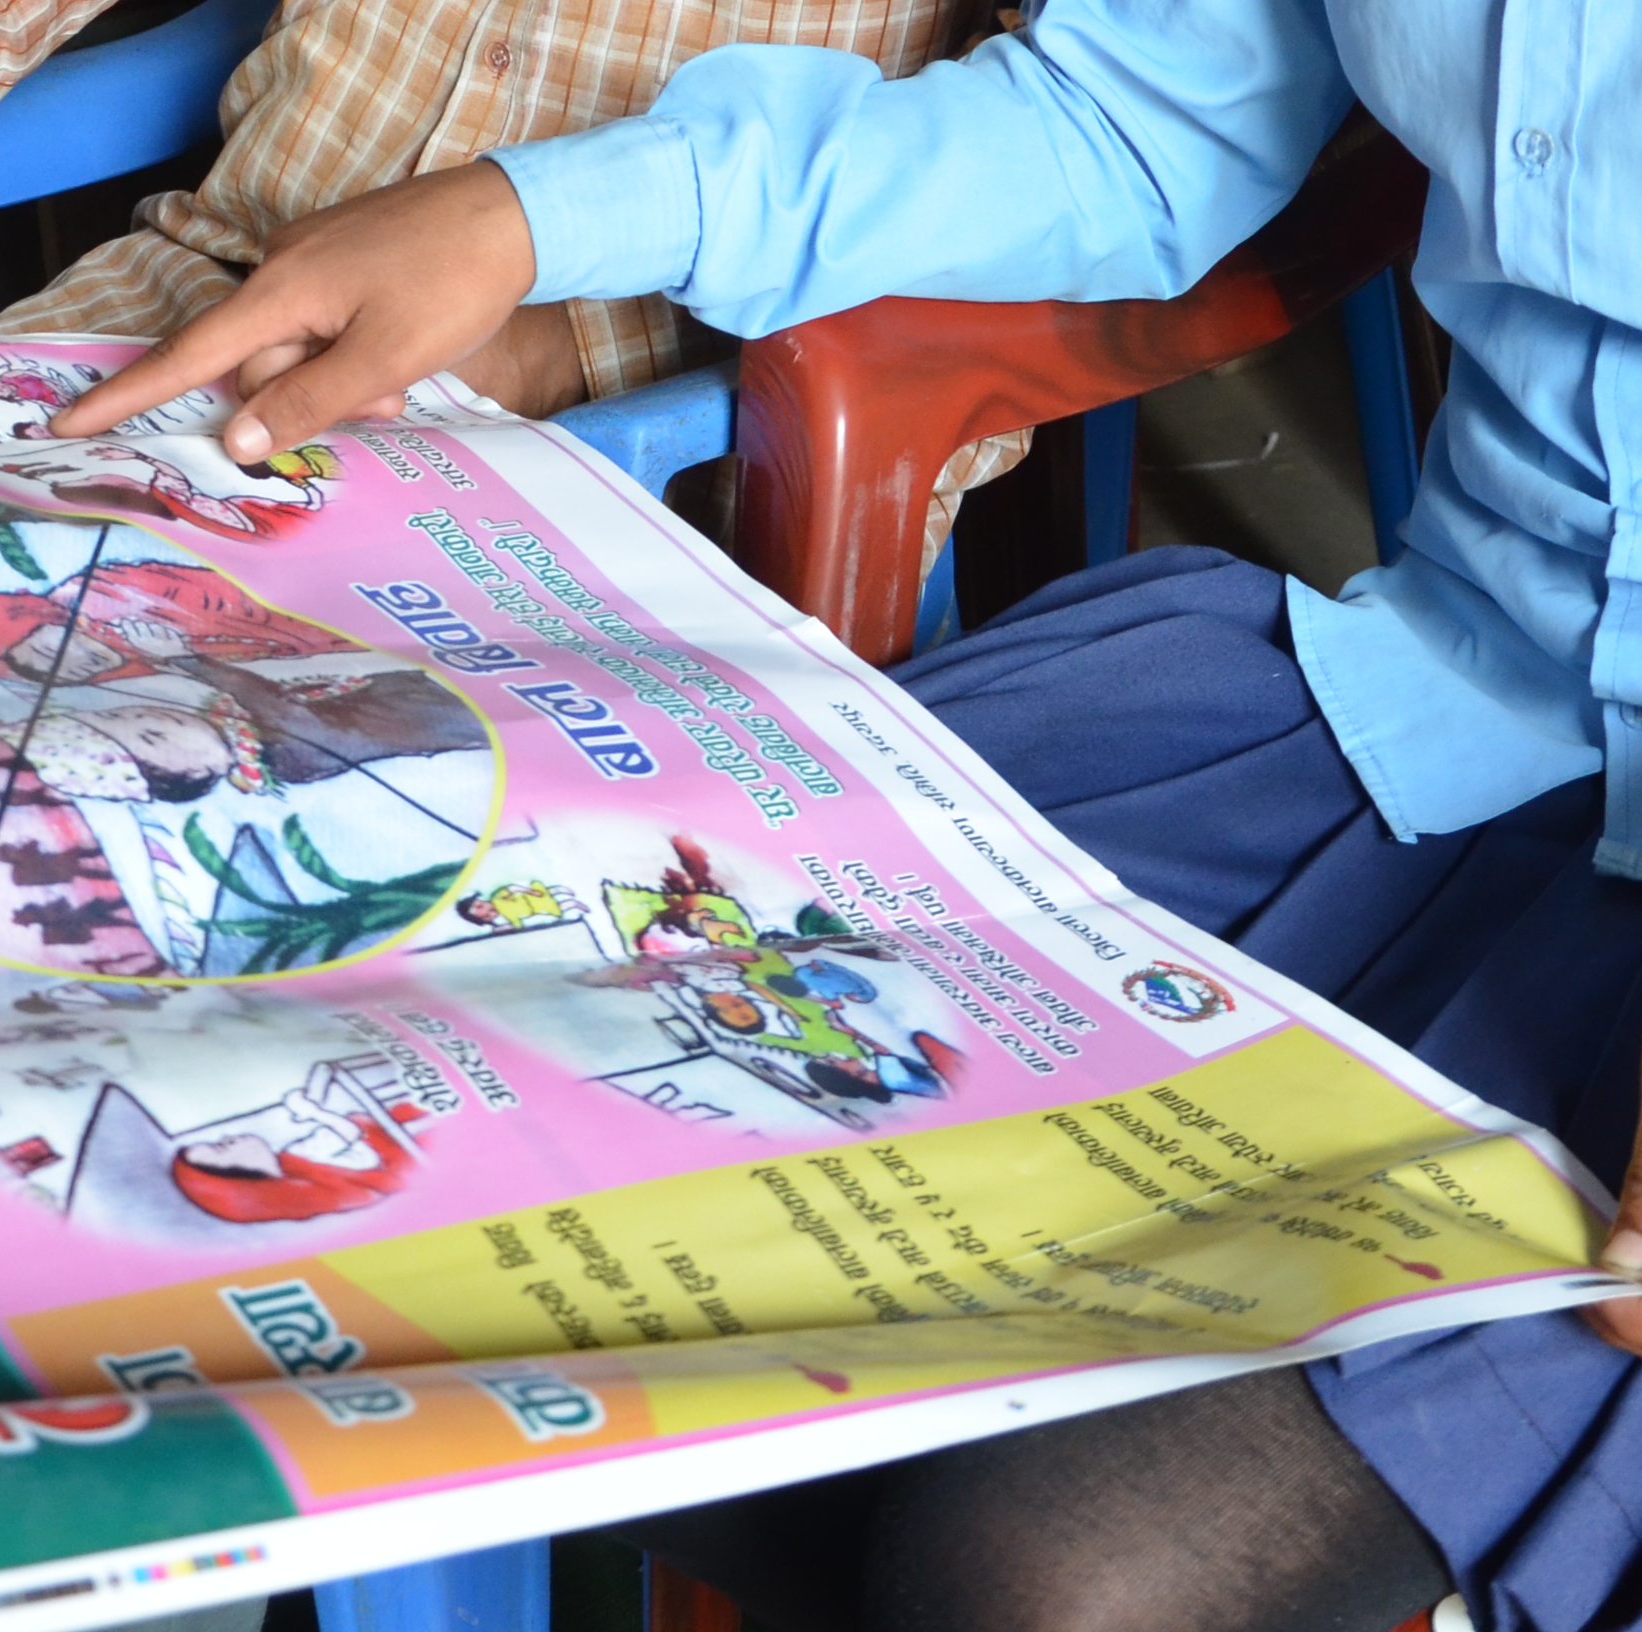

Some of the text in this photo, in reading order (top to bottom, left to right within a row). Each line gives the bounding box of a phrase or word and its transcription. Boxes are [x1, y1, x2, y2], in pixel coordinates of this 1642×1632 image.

[506, 682, 655, 779] बाल
[684, 721, 765, 786] परिवार
[829, 703, 899, 755] उदयपुर
[952, 817, 1058, 913] बालकल्याण
[1056, 915, 1127, 960] जिल्ला
[962, 968, 1016, 1007] आमा
[1033, 990, 1097, 1032] जीवन
[1012, 1009, 1078, 1056] कारण
